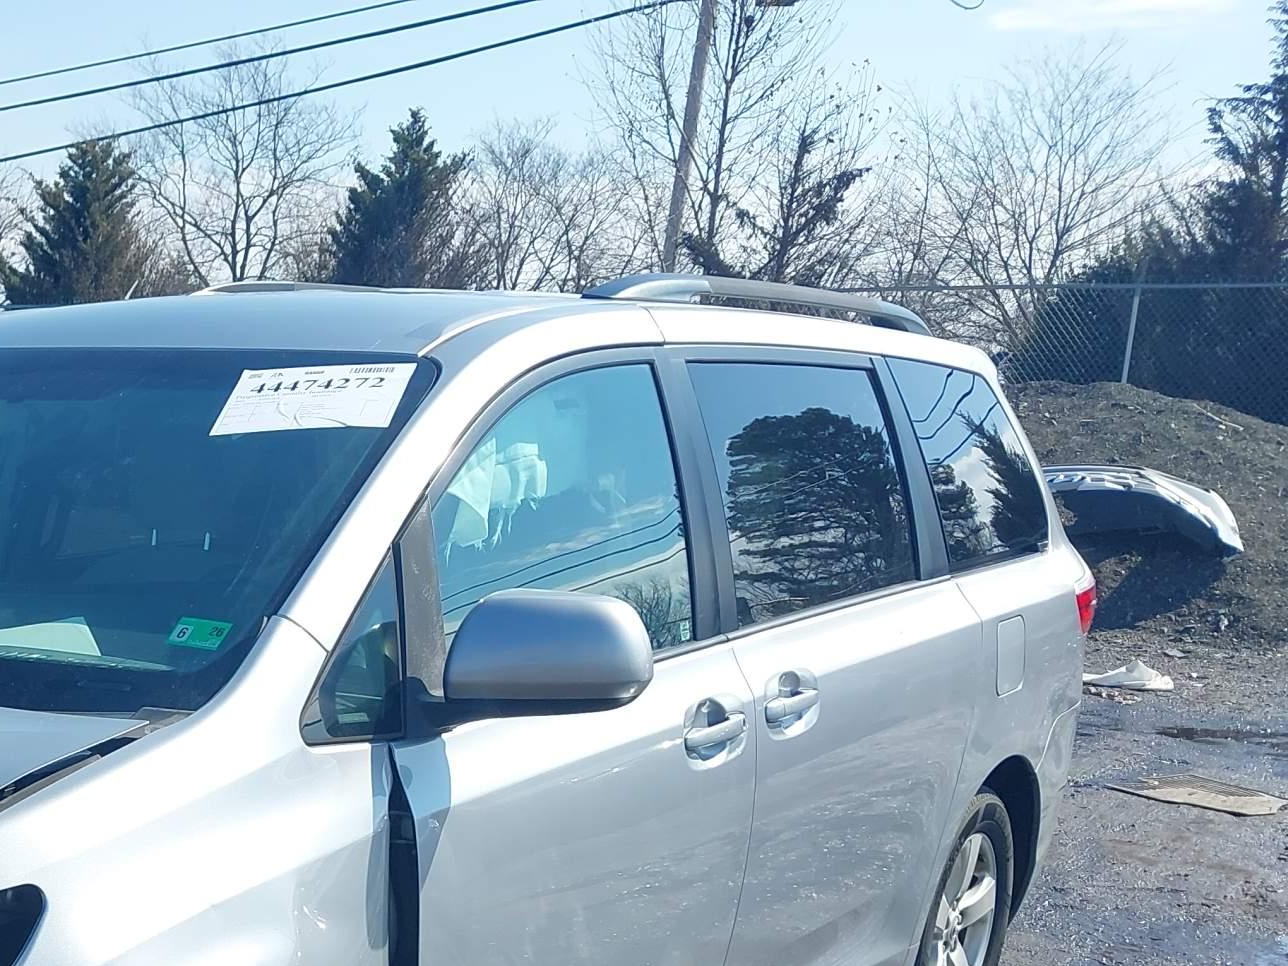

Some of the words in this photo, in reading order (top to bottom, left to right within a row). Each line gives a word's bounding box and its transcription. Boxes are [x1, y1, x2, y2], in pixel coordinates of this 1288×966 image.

[250, 376, 386, 394] 44474272
[176, 627, 189, 639] 6
[209, 626, 226, 637] 26
